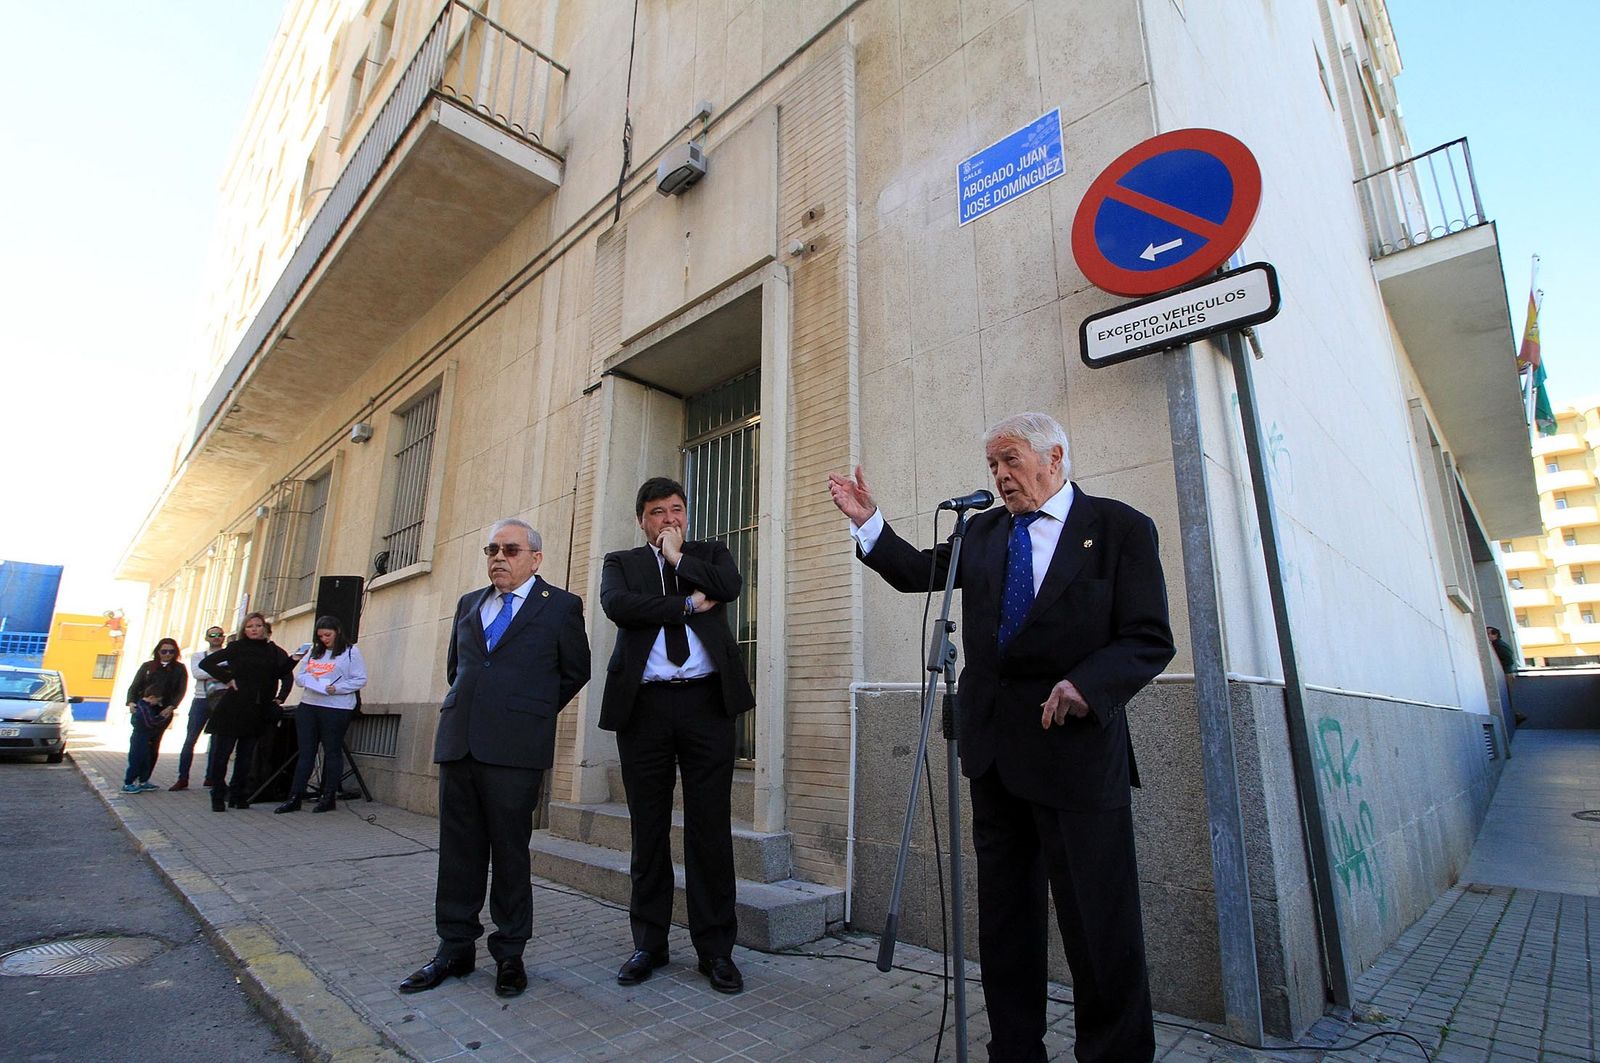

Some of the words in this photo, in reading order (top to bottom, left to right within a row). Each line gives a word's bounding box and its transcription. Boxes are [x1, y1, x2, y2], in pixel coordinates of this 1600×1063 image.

[963, 163, 1014, 200] ABOGADO
[1017, 144, 1048, 172] JUAN
[963, 168, 982, 182] CALLE
[964, 191, 991, 218] JOSÉ
[993, 157, 1061, 203] DOMÍNGUEZ
[1098, 315, 1159, 341] EXCEPTO
[1162, 289, 1246, 321] VEHICULOS
[1125, 312, 1206, 344] POLICIALES
